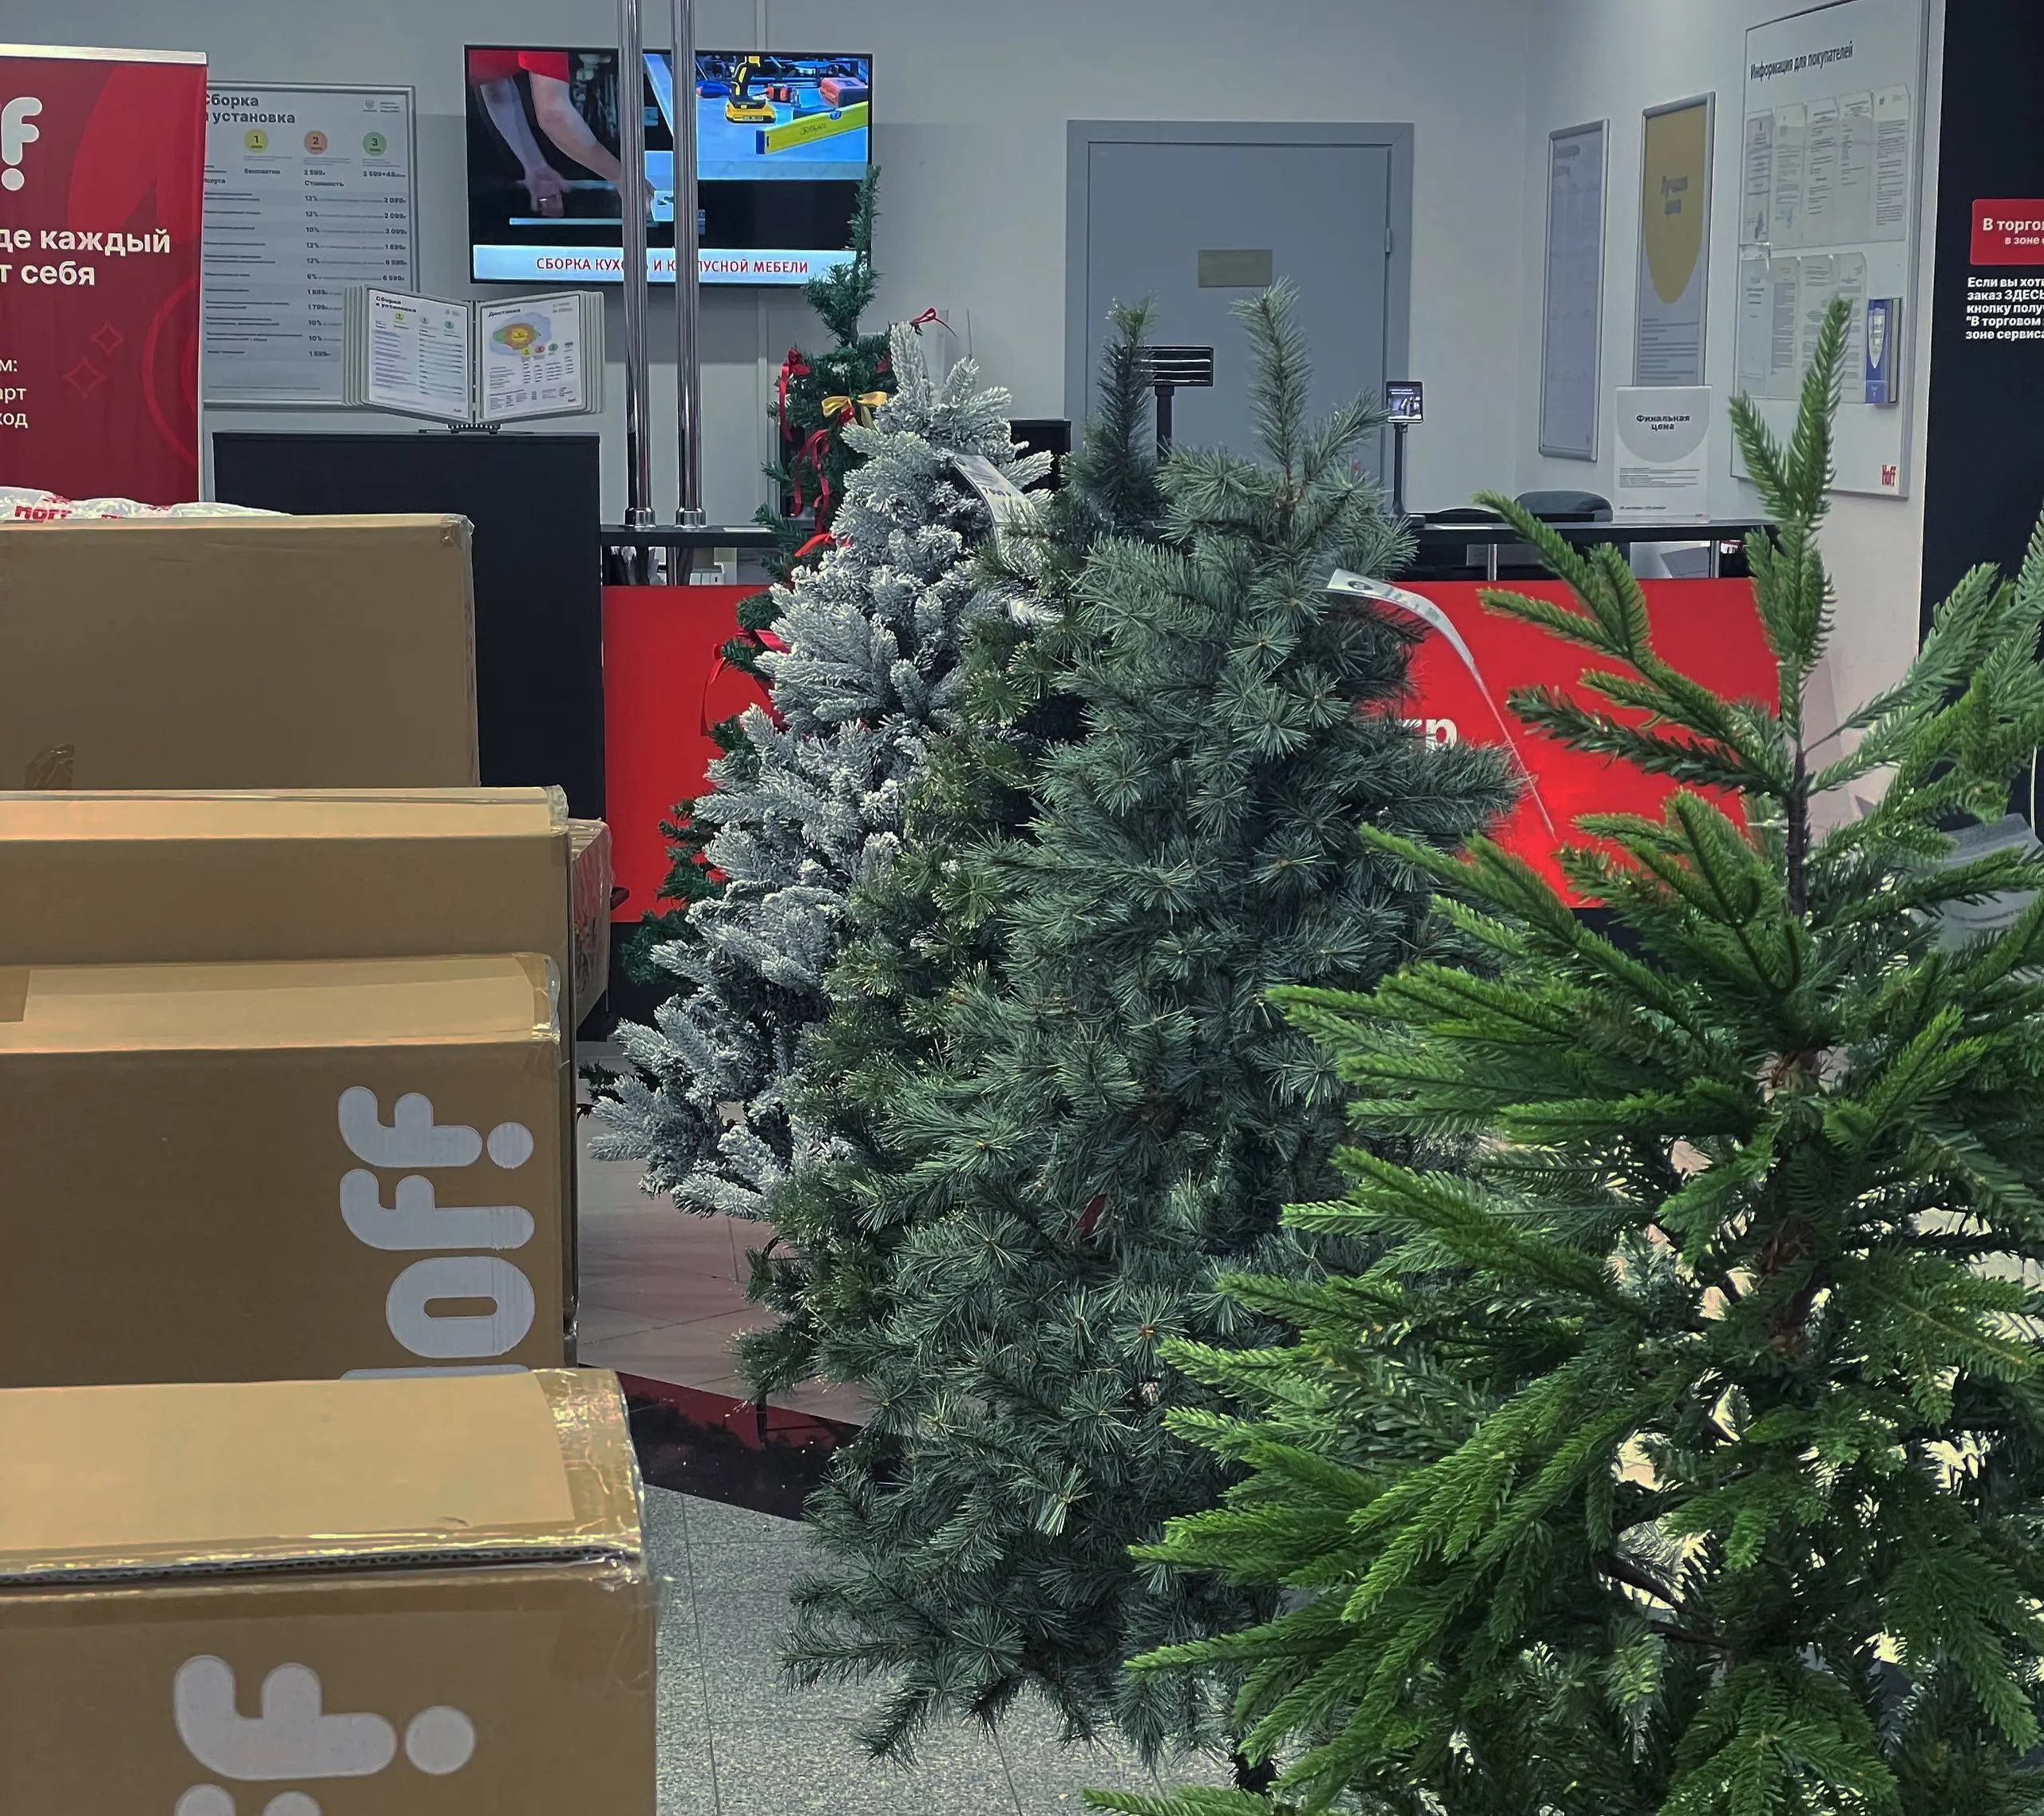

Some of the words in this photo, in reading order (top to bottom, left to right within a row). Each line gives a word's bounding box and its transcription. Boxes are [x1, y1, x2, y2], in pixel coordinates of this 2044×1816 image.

[212, 112, 295, 125] установка
[254, 135, 259, 144] 1
[312, 136, 319, 145] 2
[1983, 218, 1994, 231] В
[1997, 220, 2044, 234] торго
[41, 228, 170, 257] каждый
[537, 258, 591, 270] СБОРКА
[596, 259, 648, 271] КУХ
[654, 259, 662, 271] И
[667, 259, 749, 273] КПУСНОЙ
[754, 261, 808, 274] МЕБЕЛИ
[21, 261, 95, 286] себя
[1967, 277, 1998, 287] Если
[2000, 279, 2018, 287] вы
[1967, 292, 2002, 301] заказ
[2004, 290, 2044, 303] ЗДЕСЬ
[1967, 305, 2012, 316] кнопку
[2013, 305, 2044, 316] полу
[1982, 318, 2042, 329] торговом
[1966, 330, 1995, 339] зоне
[0, 413, 28, 429] од
[339, 1086, 535, 1379] off
